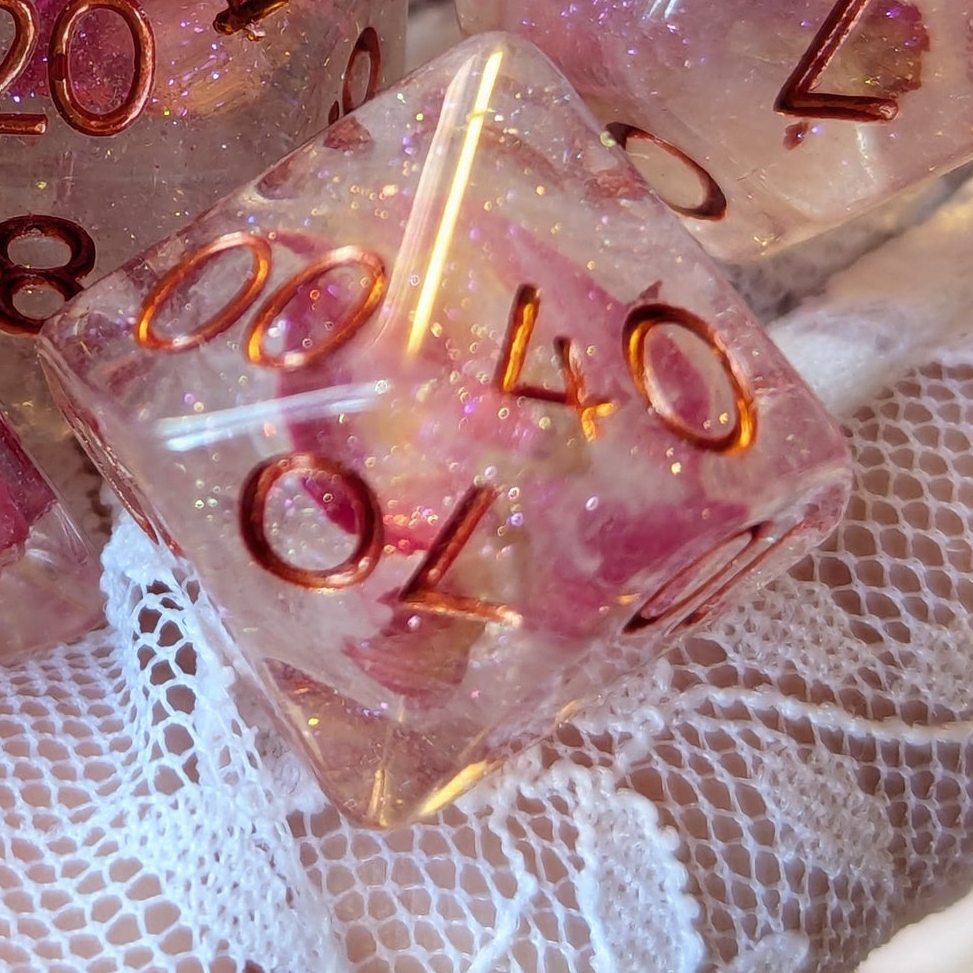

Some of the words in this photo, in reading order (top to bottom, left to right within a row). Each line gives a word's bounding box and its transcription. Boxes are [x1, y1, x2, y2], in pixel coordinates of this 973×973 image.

[135, 231, 388, 369] 00
[493, 283, 760, 454] 40
[239, 451, 523, 627] 70
